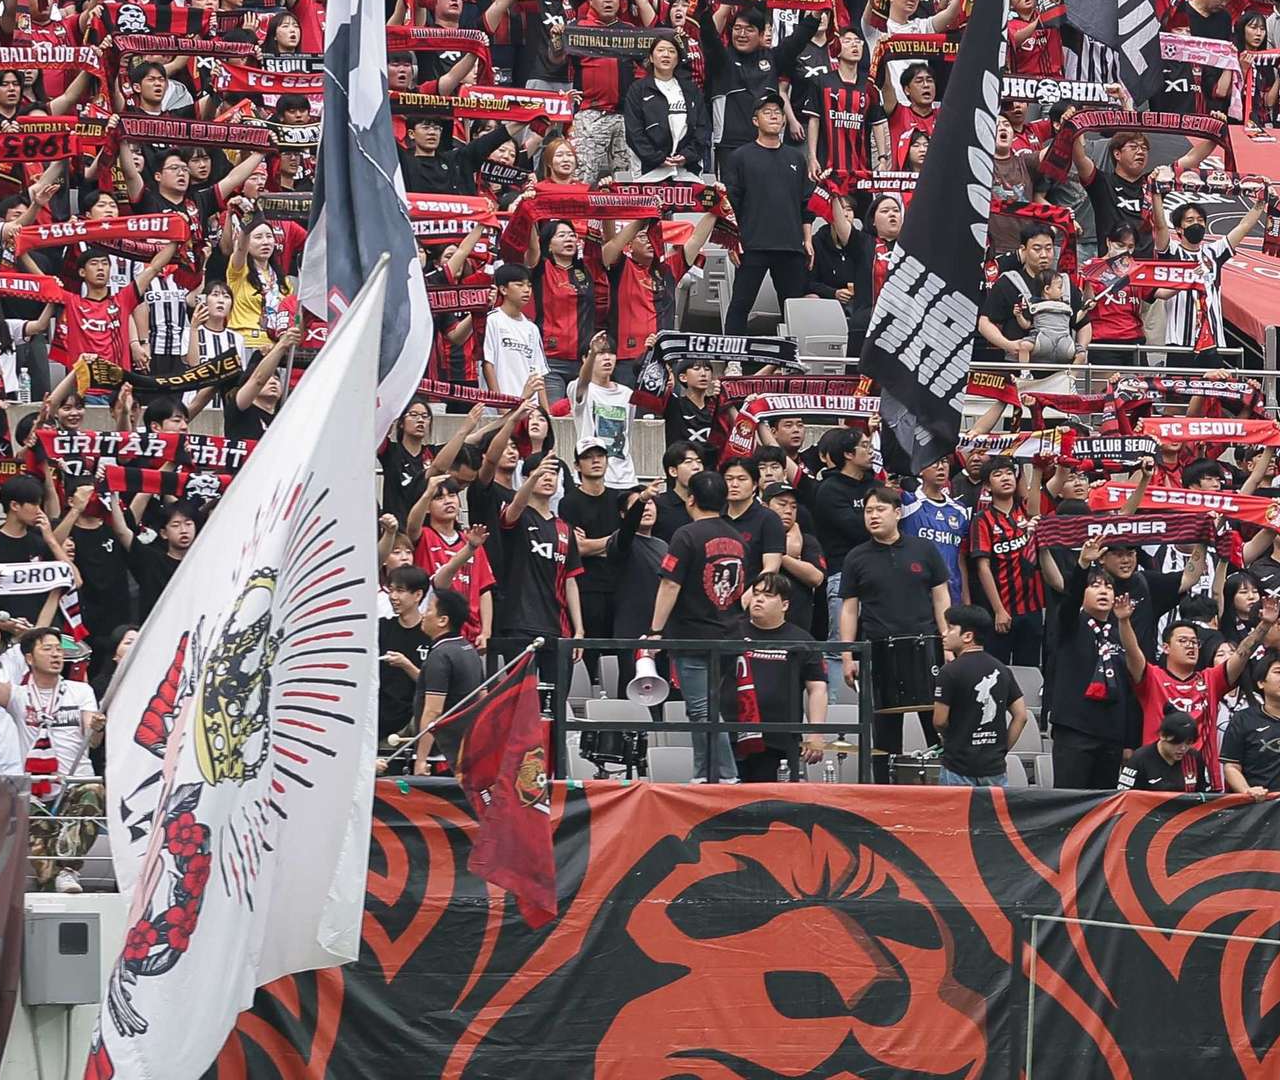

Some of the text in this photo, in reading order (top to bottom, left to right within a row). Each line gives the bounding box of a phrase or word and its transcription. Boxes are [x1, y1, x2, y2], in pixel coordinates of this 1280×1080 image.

[248, 72, 274, 87] FC
[412, 222, 457, 235] HELLO
[688, 336, 748, 353] FC SEOUL
[767, 396, 855, 411] FOOTBALL CLUB
[1160, 421, 1247, 437] FC SEOUL
[54, 436, 165, 456] GRITAR
[1087, 520, 1167, 537] RAPIER
